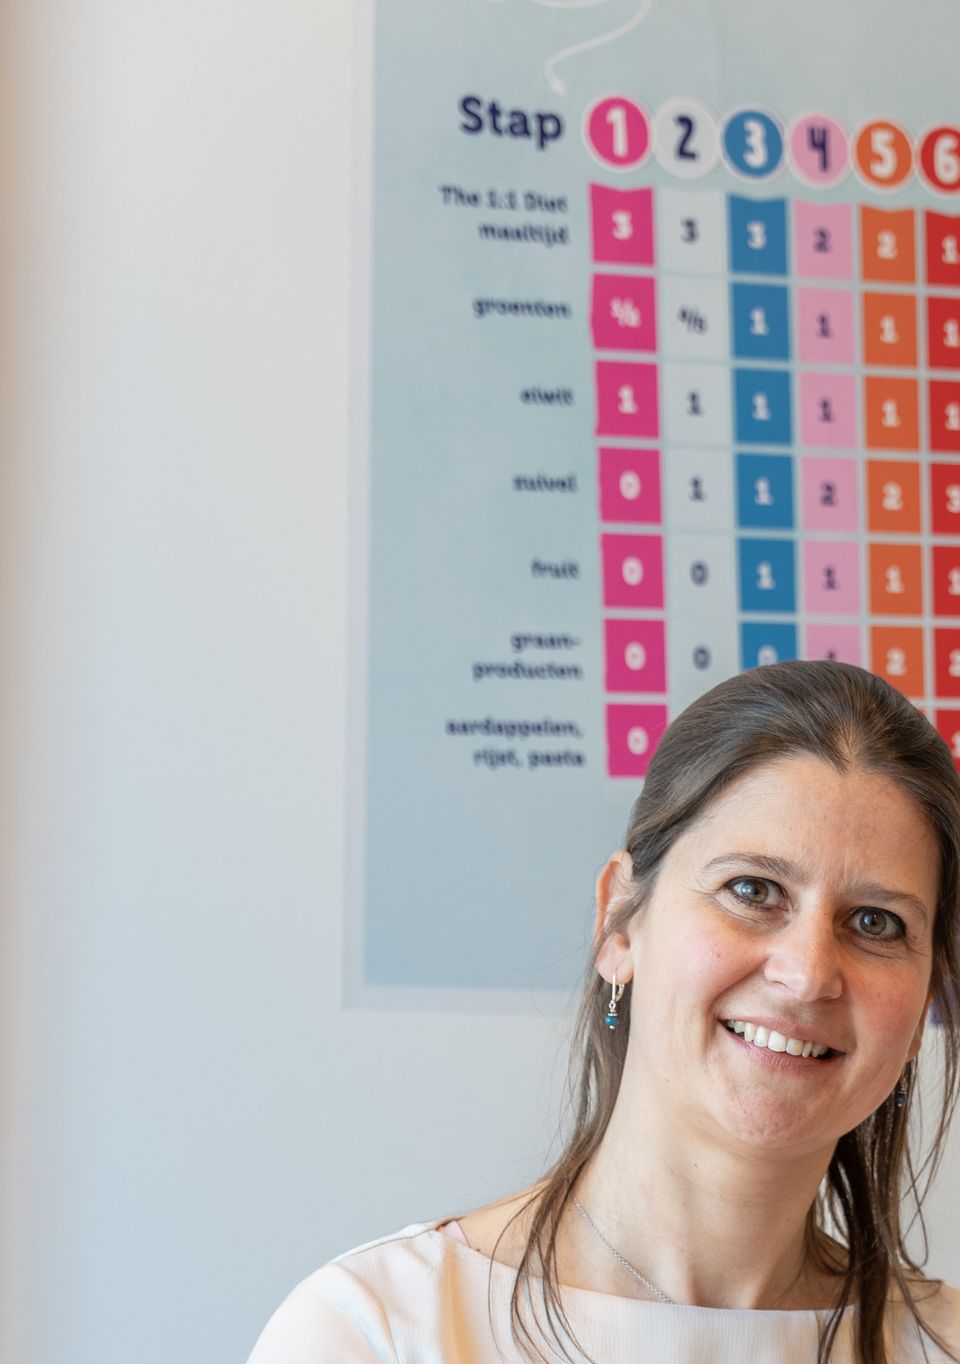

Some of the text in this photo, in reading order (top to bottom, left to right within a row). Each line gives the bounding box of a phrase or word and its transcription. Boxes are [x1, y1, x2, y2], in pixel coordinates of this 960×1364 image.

[458, 95, 564, 151] Stap
[606, 106, 628, 157] 1
[676, 115, 697, 160] 2
[745, 120, 767, 167] 3
[808, 127, 829, 171] 4
[869, 128, 899, 179] 5
[440, 185, 480, 209] The
[612, 211, 633, 240] 3
[683, 218, 700, 244] 3
[747, 221, 766, 249] 3
[814, 228, 832, 254] 2
[877, 231, 897, 259] 2
[942, 236, 960, 264] 1
[751, 308, 768, 335] 1
[817, 314, 832, 339] 1
[880, 316, 897, 344] 1
[943, 320, 960, 348] 1
[618, 386, 637, 414] 1
[688, 391, 703, 417] 1
[753, 393, 770, 421] 1
[820, 399, 835, 424] 1
[882, 400, 900, 427] 1
[619, 471, 641, 500] 0
[691, 477, 706, 502] 1
[755, 478, 772, 505] 1
[820, 482, 838, 508] 2
[883, 483, 902, 511] 2
[530, 558, 580, 580] fruit
[622, 556, 643, 586] 0
[690, 561, 709, 586] 0
[757, 563, 774, 590] 1
[824, 566, 839, 591] 1
[886, 567, 903, 594] 1
[472, 661, 583, 681] producten
[624, 642, 646, 671] 0
[693, 646, 711, 670] 0
[886, 647, 906, 677] 2
[627, 727, 649, 756] 0
